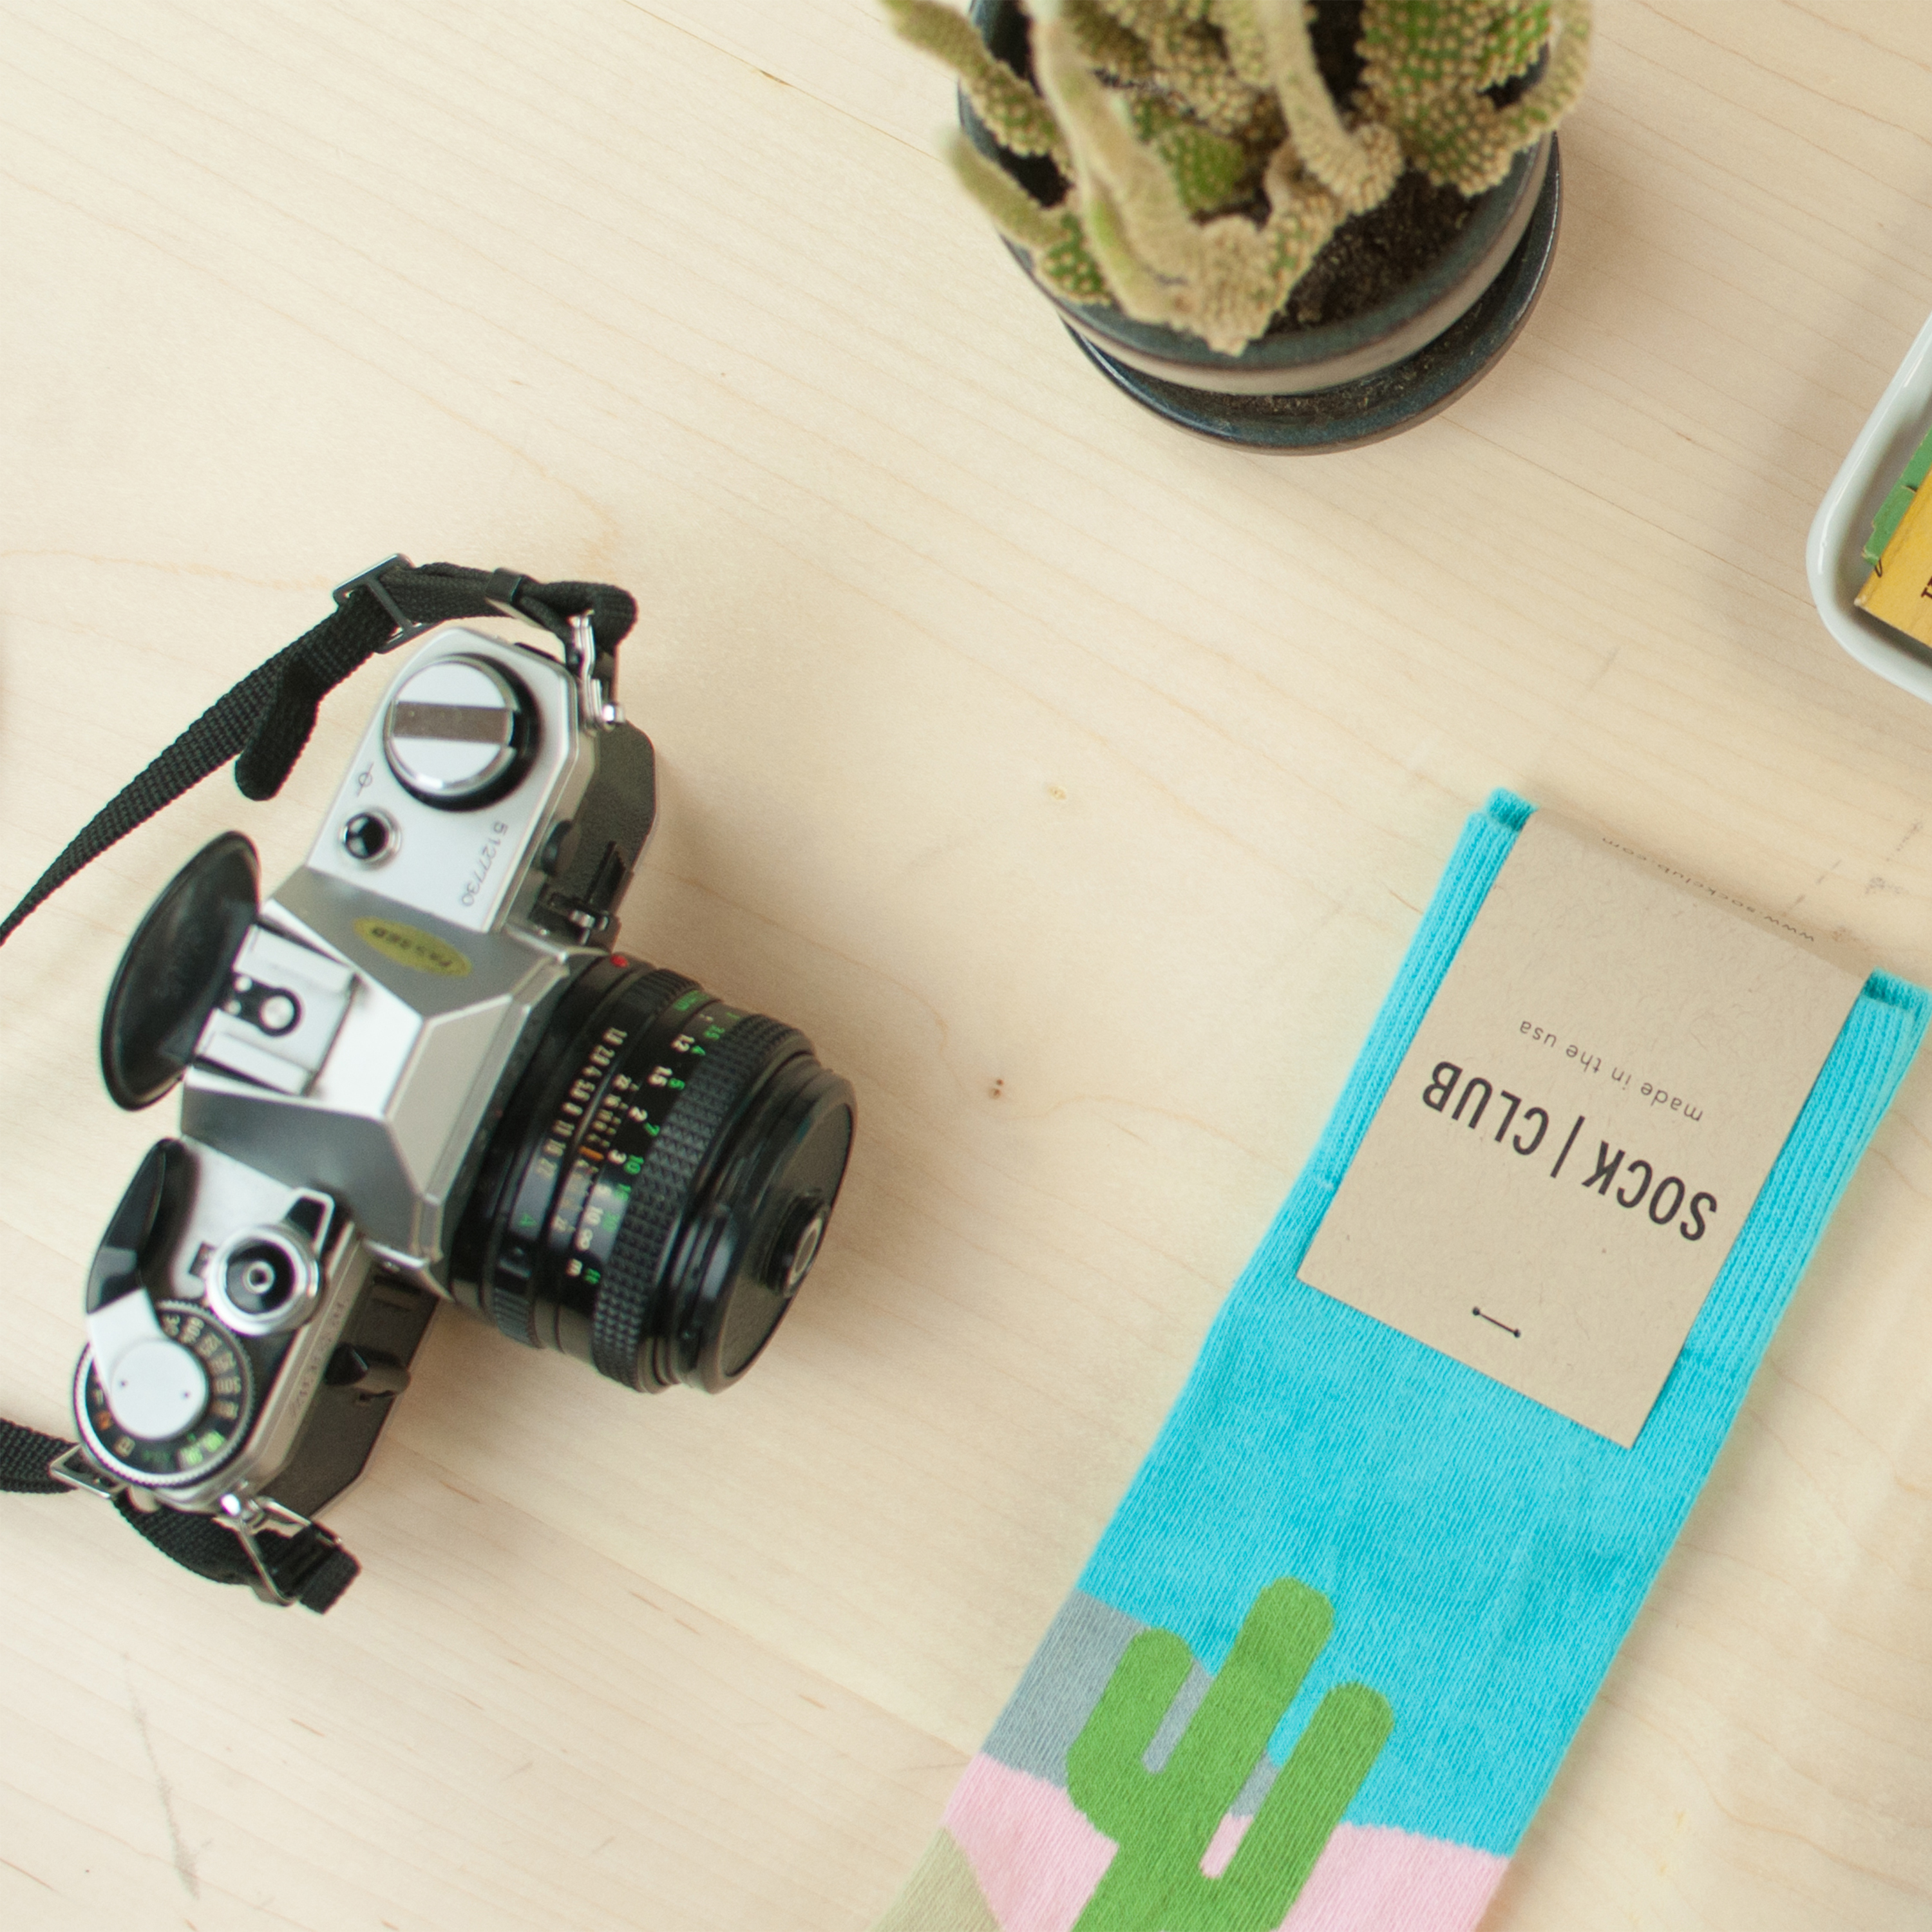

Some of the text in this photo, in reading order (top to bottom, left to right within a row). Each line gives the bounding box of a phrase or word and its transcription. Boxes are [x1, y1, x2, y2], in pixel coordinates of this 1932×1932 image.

[461, 821, 507, 906] 5127730
[1602, 837, 1815, 943] www.sockclub.com
[629, 1106, 648, 1121] 2
[1423, 1061, 1549, 1156] CLUB
[1519, 1021, 1703, 1122] made in the usa
[609, 1150, 627, 1164] 3
[624, 1155, 644, 1174] 10
[1582, 1141, 1718, 1242] SOCK
